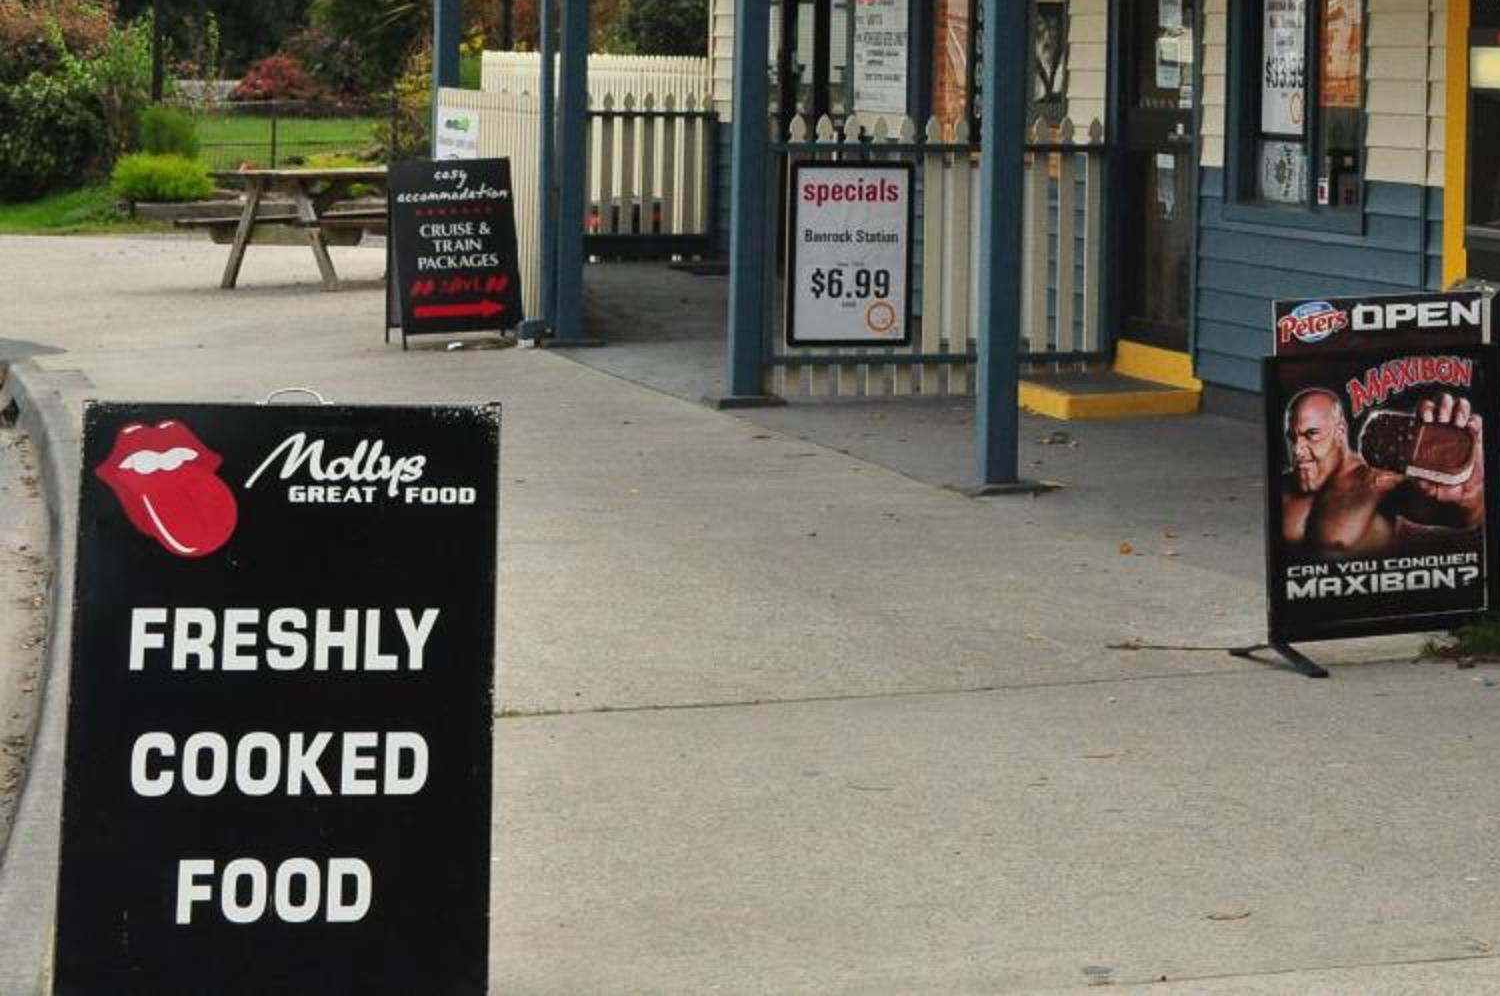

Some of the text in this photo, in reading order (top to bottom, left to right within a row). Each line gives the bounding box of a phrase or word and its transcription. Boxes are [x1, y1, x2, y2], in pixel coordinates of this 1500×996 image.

[397, 182, 509, 203] accommodation
[803, 178, 899, 207] specials
[419, 221, 492, 238] CRUISE &
[855, 229, 899, 244] Station
[432, 238, 483, 253] TRAIN
[417, 253, 499, 270] PACKAGES
[811, 267, 890, 299] $6.99
[1278, 309, 1349, 343] Peters
[1351, 300, 1481, 330] OPEN
[1346, 355, 1473, 413] MAXIBON
[244, 432, 427, 497] Mollys
[288, 485, 477, 505] GREAT FOOD
[1287, 552, 1479, 578] CAN YOU CONQUER
[1286, 566, 1480, 601] MAXIBON?
[129, 607, 440, 672] FRESHLY
[130, 731, 430, 797] COOKED
[175, 857, 373, 924] FOOD
